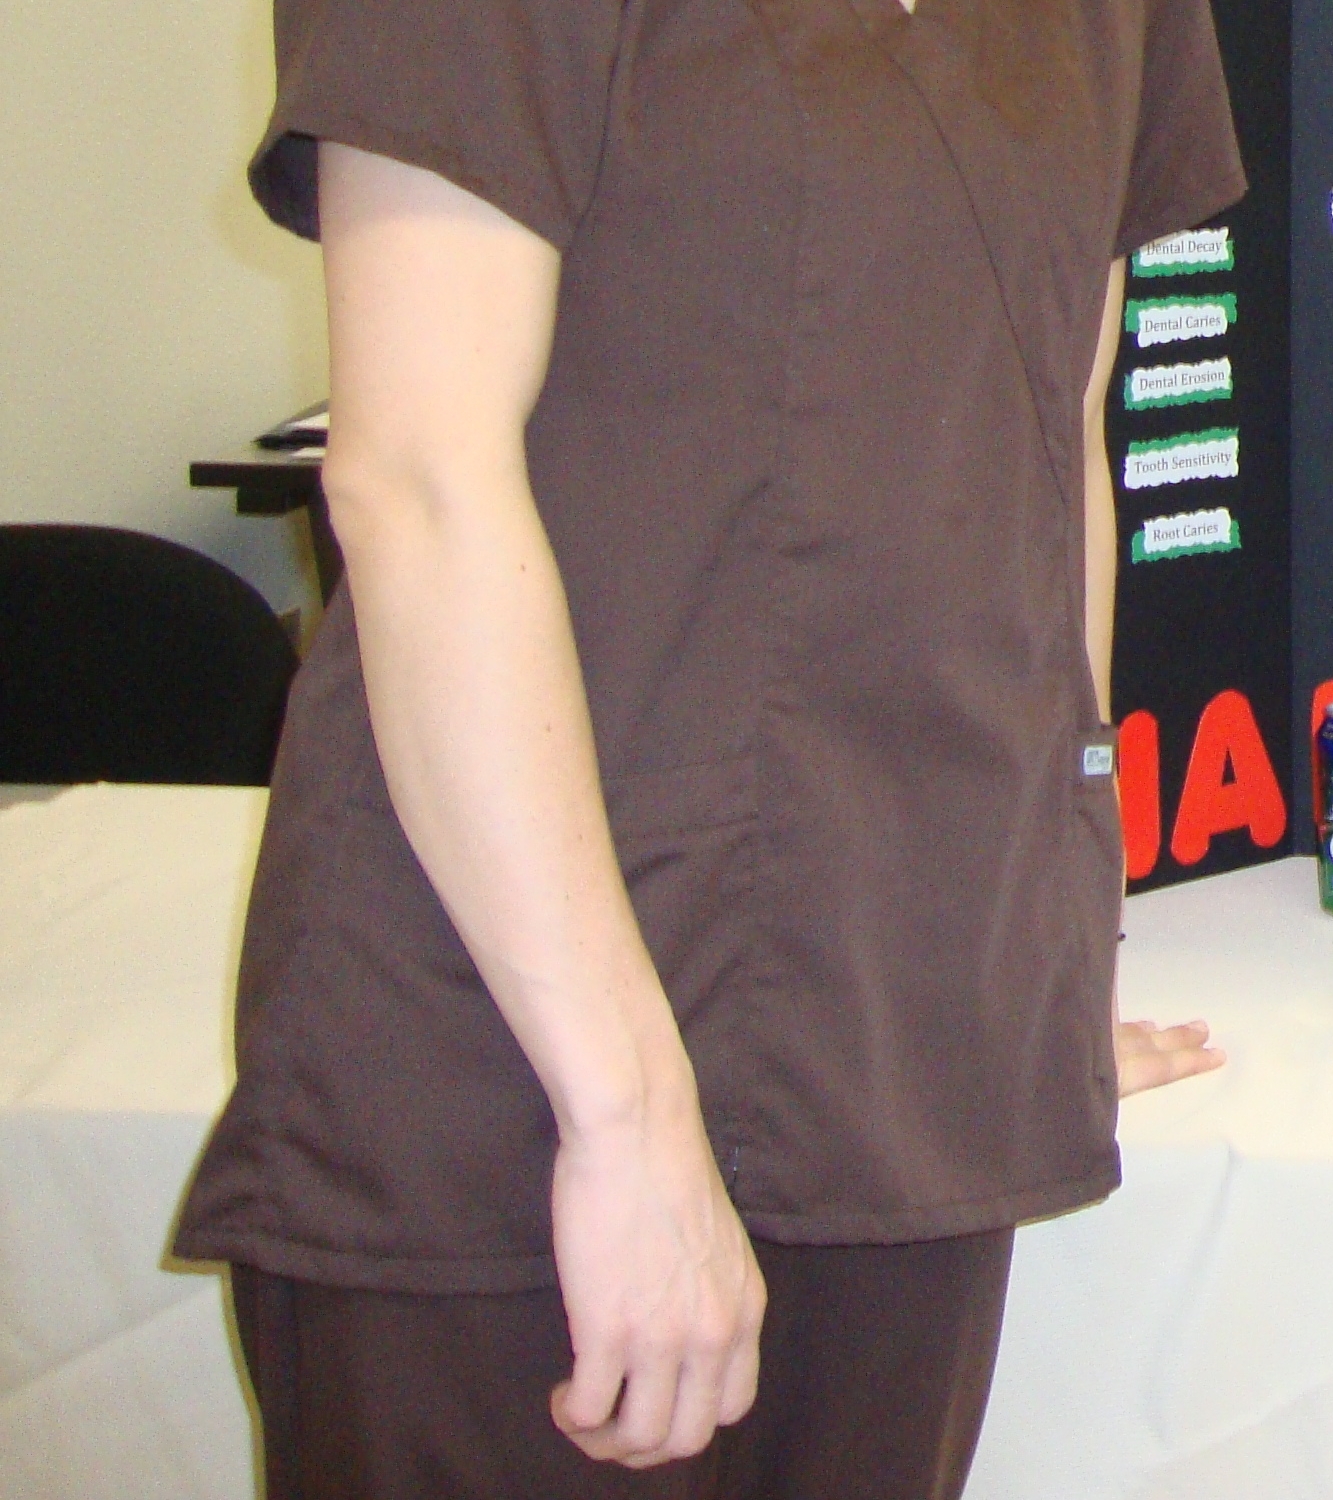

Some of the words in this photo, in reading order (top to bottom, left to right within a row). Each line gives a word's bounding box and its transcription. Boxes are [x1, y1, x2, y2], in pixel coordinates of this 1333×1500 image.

[1147, 240, 1184, 256] Dental
[1188, 240, 1222, 256] Decay
[1144, 316, 1183, 334] Dental
[1186, 315, 1221, 329] Caries
[1139, 374, 1177, 392] Dental
[1181, 370, 1225, 386] Erosion
[1134, 458, 1169, 475] Tooth
[1172, 452, 1231, 471] Sensitivity
[1153, 527, 1180, 542] Root
[1183, 523, 1218, 537] Caries
